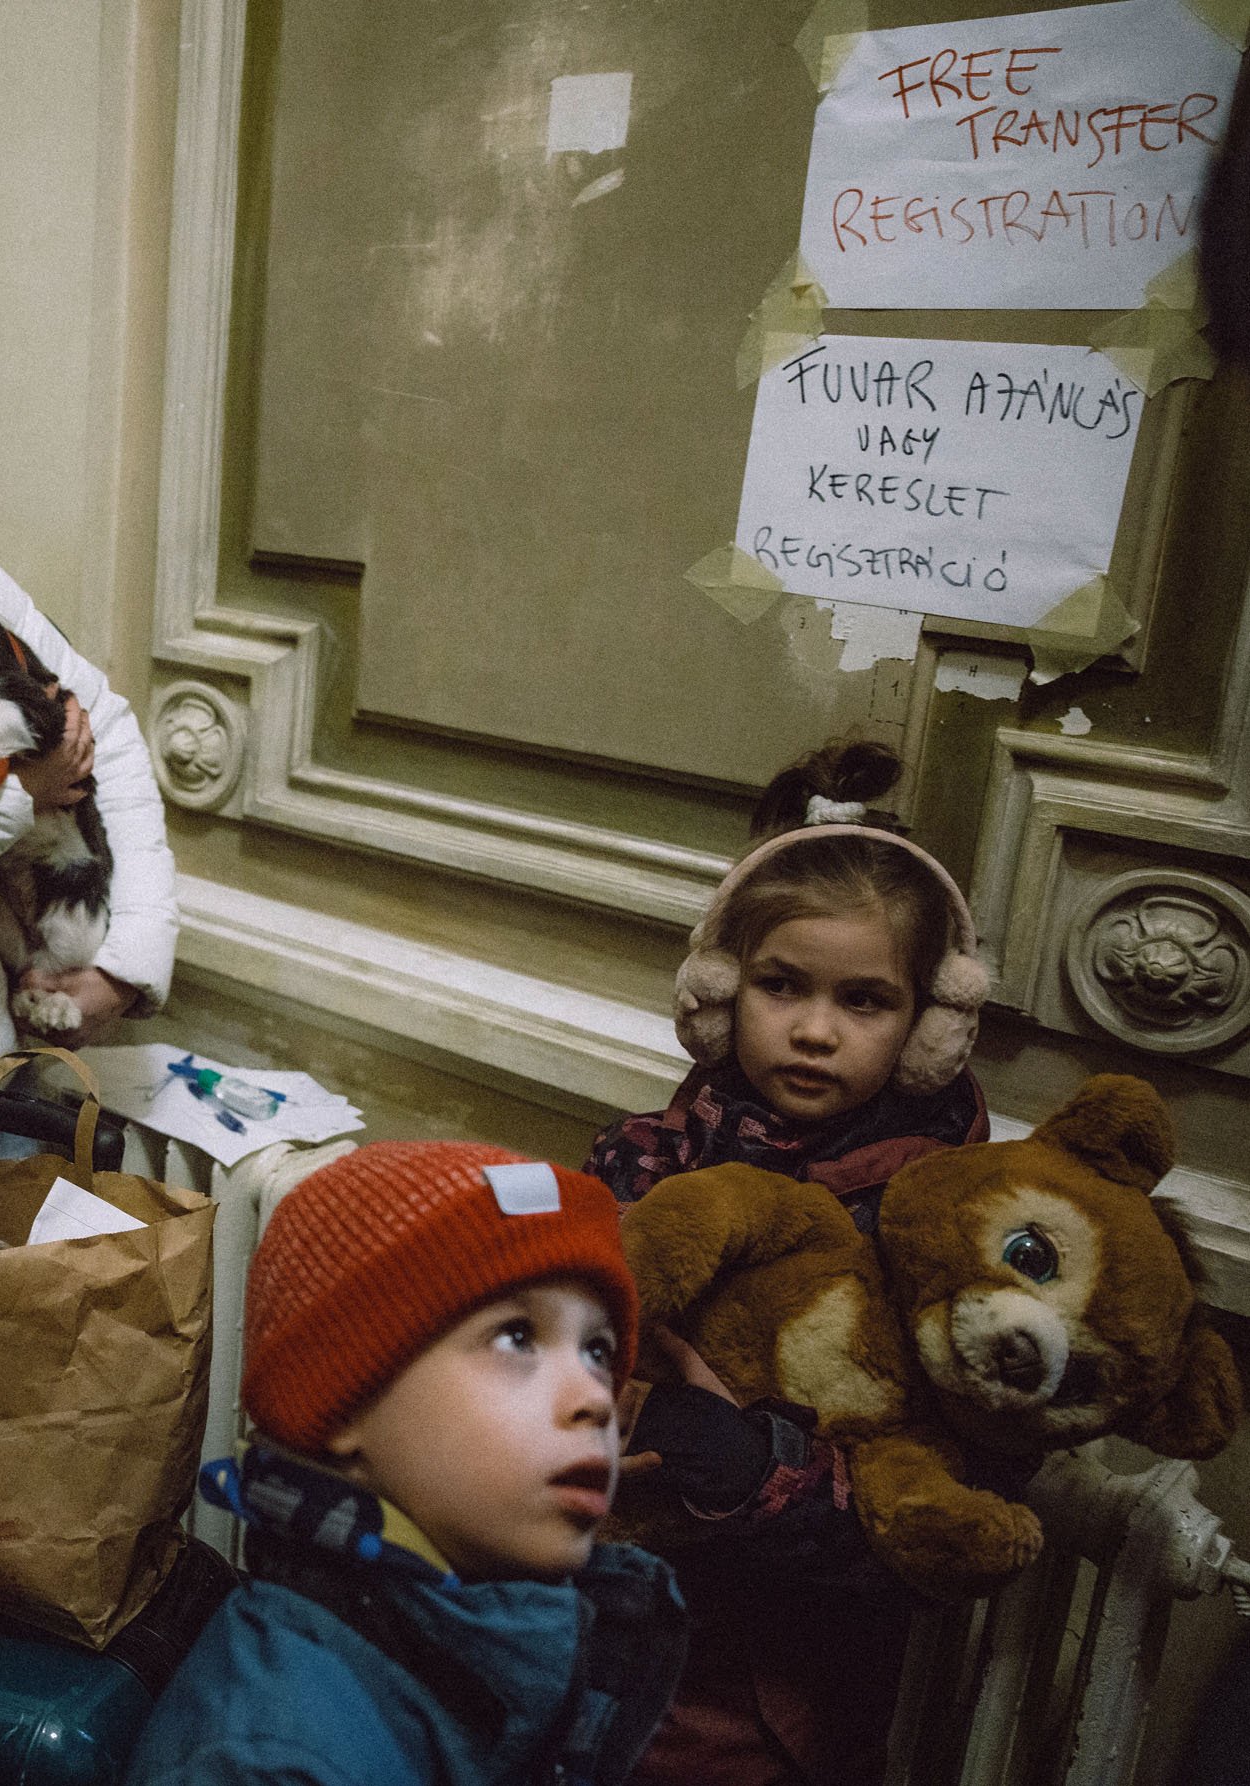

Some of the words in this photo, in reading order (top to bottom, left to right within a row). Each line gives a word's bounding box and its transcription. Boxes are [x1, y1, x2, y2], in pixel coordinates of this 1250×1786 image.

[878, 47, 1063, 118] FREE
[956, 92, 1221, 168] TRANSFER
[832, 188, 1197, 252] REGISTRATION
[782, 345, 936, 412] FUVAR
[857, 424, 940, 465] VAGY
[808, 464, 1010, 520] KERESLET
